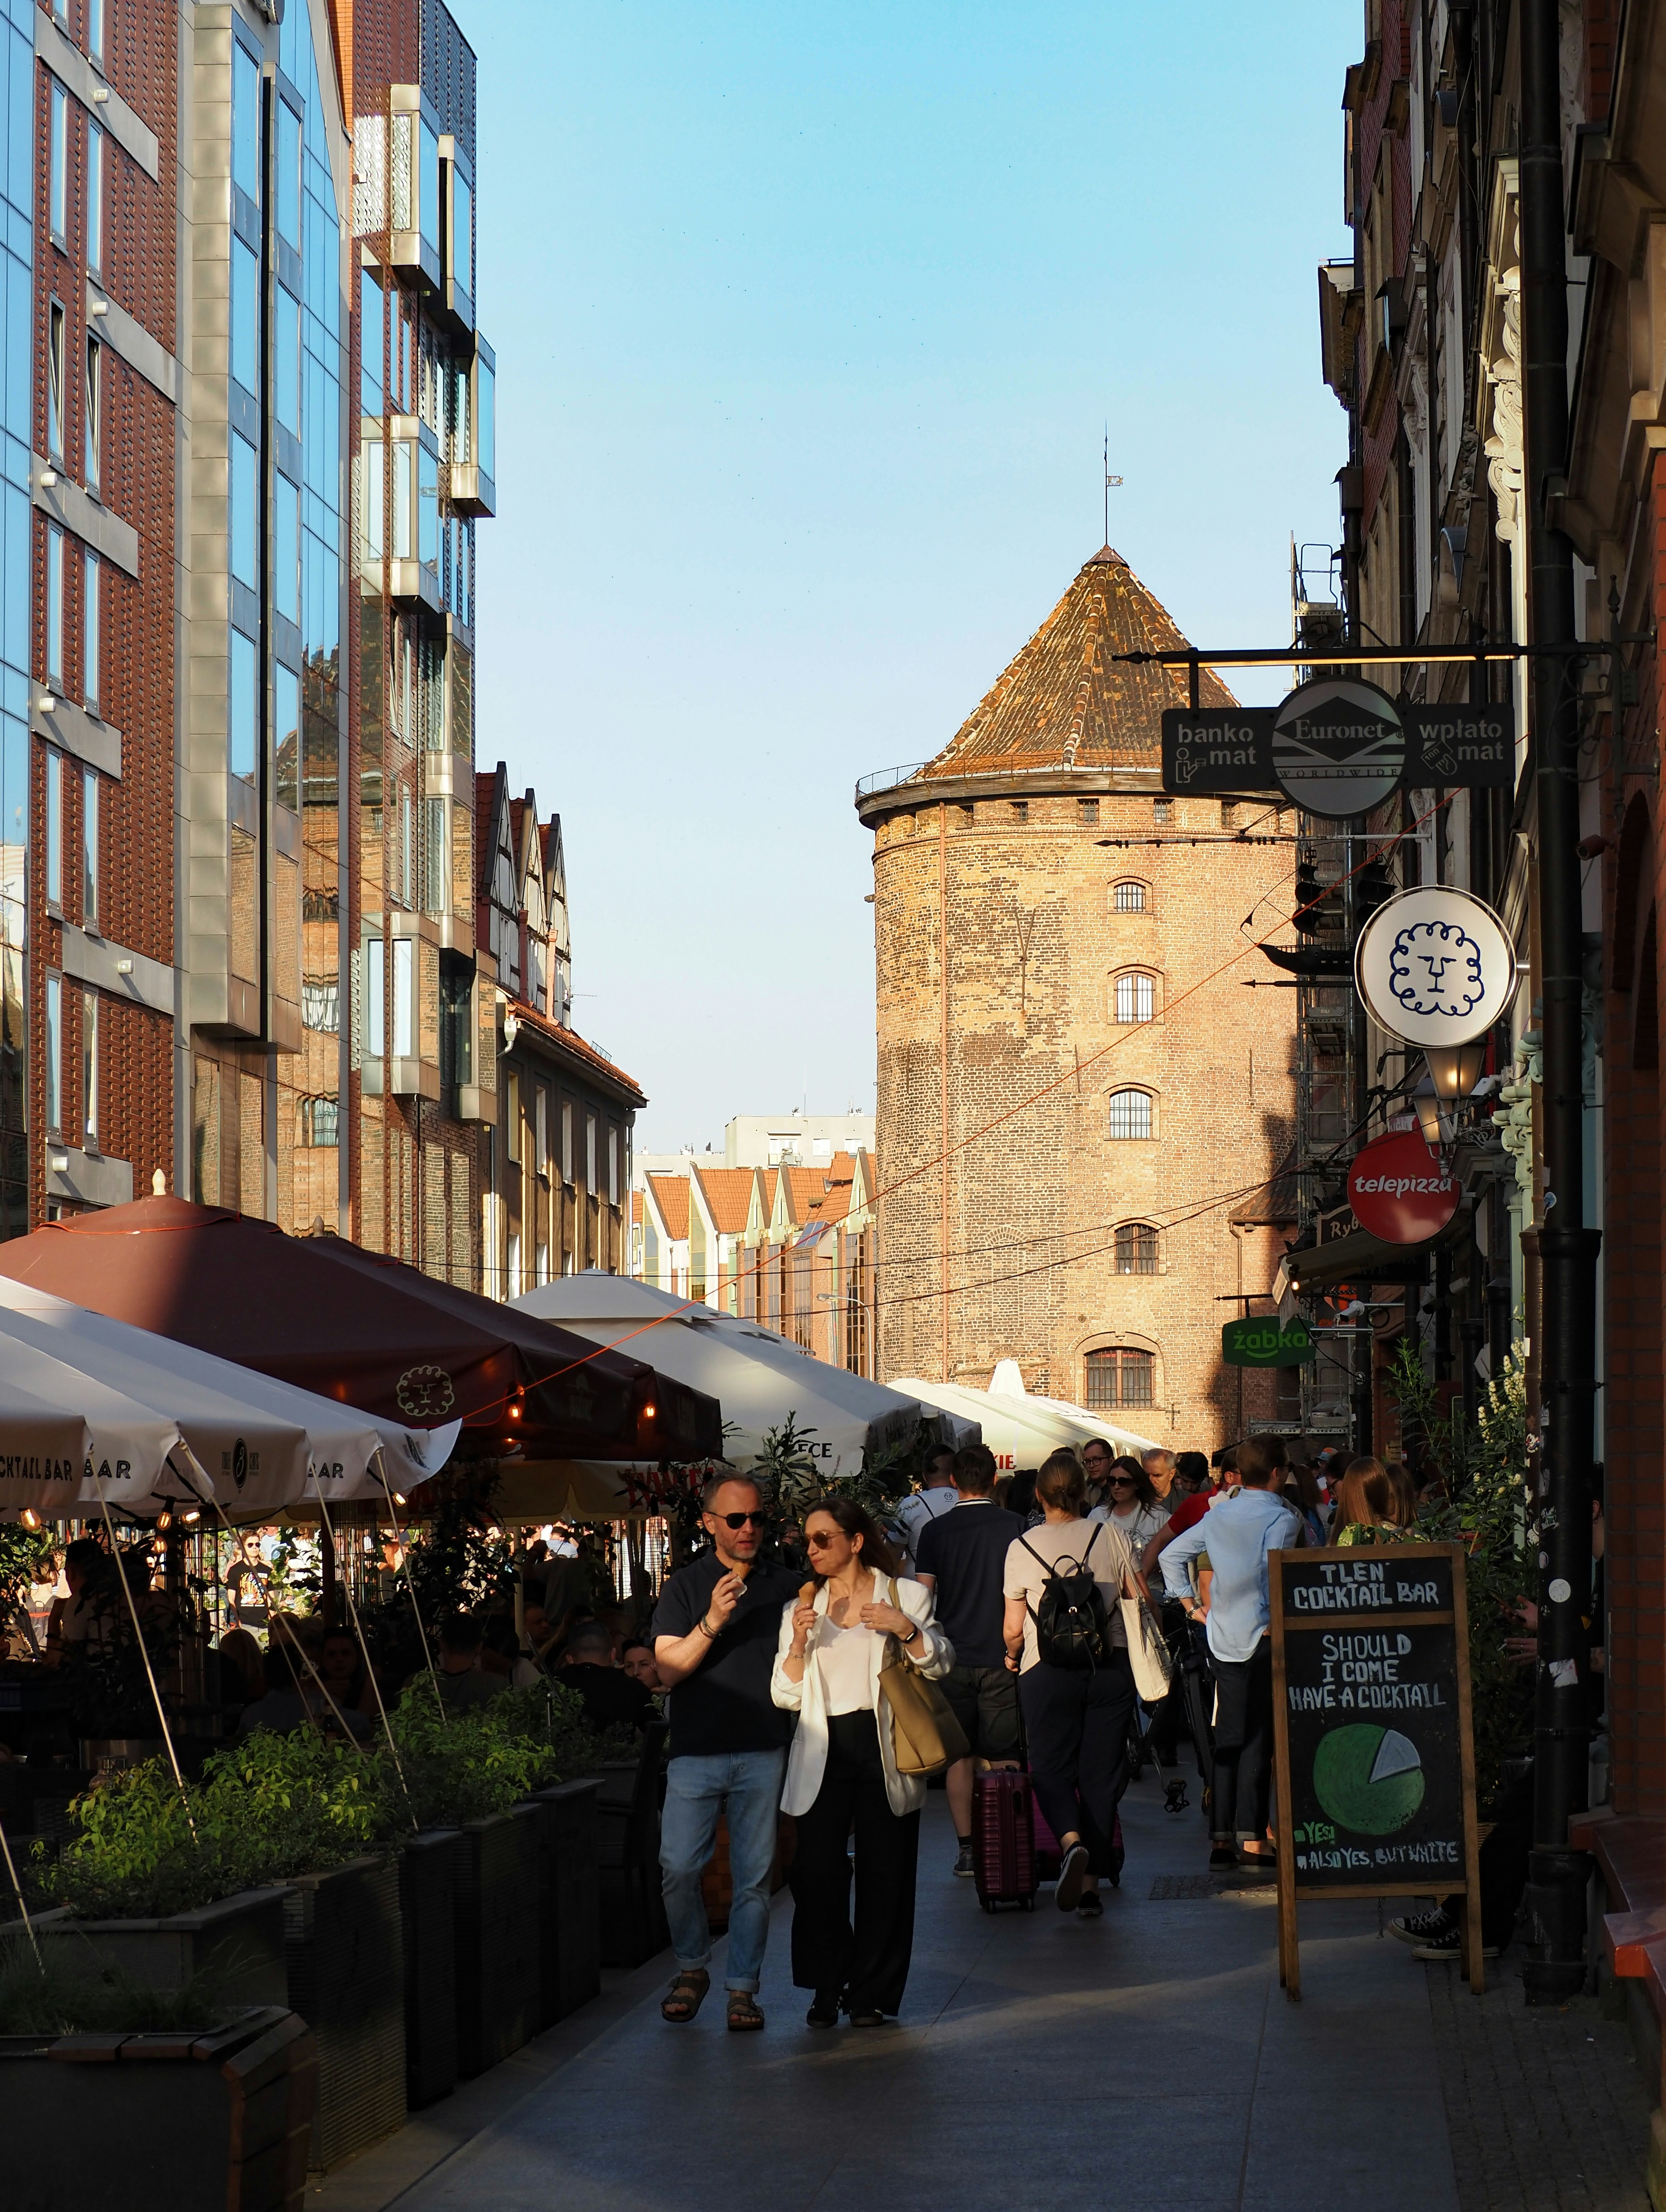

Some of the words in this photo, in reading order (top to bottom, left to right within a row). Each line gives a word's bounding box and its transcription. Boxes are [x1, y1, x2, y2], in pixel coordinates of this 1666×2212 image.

[1178, 724, 1254, 743] banko
[1294, 719, 1385, 739] Euronet
[1419, 719, 1503, 742] wpłato
[1210, 745, 1257, 765] mat
[1458, 741, 1503, 760] mat
[1278, 769, 1399, 778] WORLDWIDE
[1355, 1174, 1452, 1199] telepizza
[1330, 1215, 1363, 1238] Ryb
[1233, 1329, 1307, 1350] żabka
[44, 1458, 73, 1482] BAR
[83, 1458, 131, 1479] BAR
[1293, 1582, 1393, 1609] COCKTAIL
[1397, 1581, 1439, 1605] BAR
[1321, 1634, 1412, 1661] SHOULD
[1321, 1662, 1335, 1683] I
[1341, 1659, 1400, 1682] COME
[1288, 1685, 1336, 1710] HAVE
[1338, 1686, 1354, 1708] A
[1358, 1683, 1447, 1709] COCKTAIL
[1302, 1821, 1335, 1845] YES!
[1308, 1852, 1341, 1870] ALSO
[1375, 1846, 1406, 1865] BUT
[1408, 1841, 1460, 1863] WHITE
